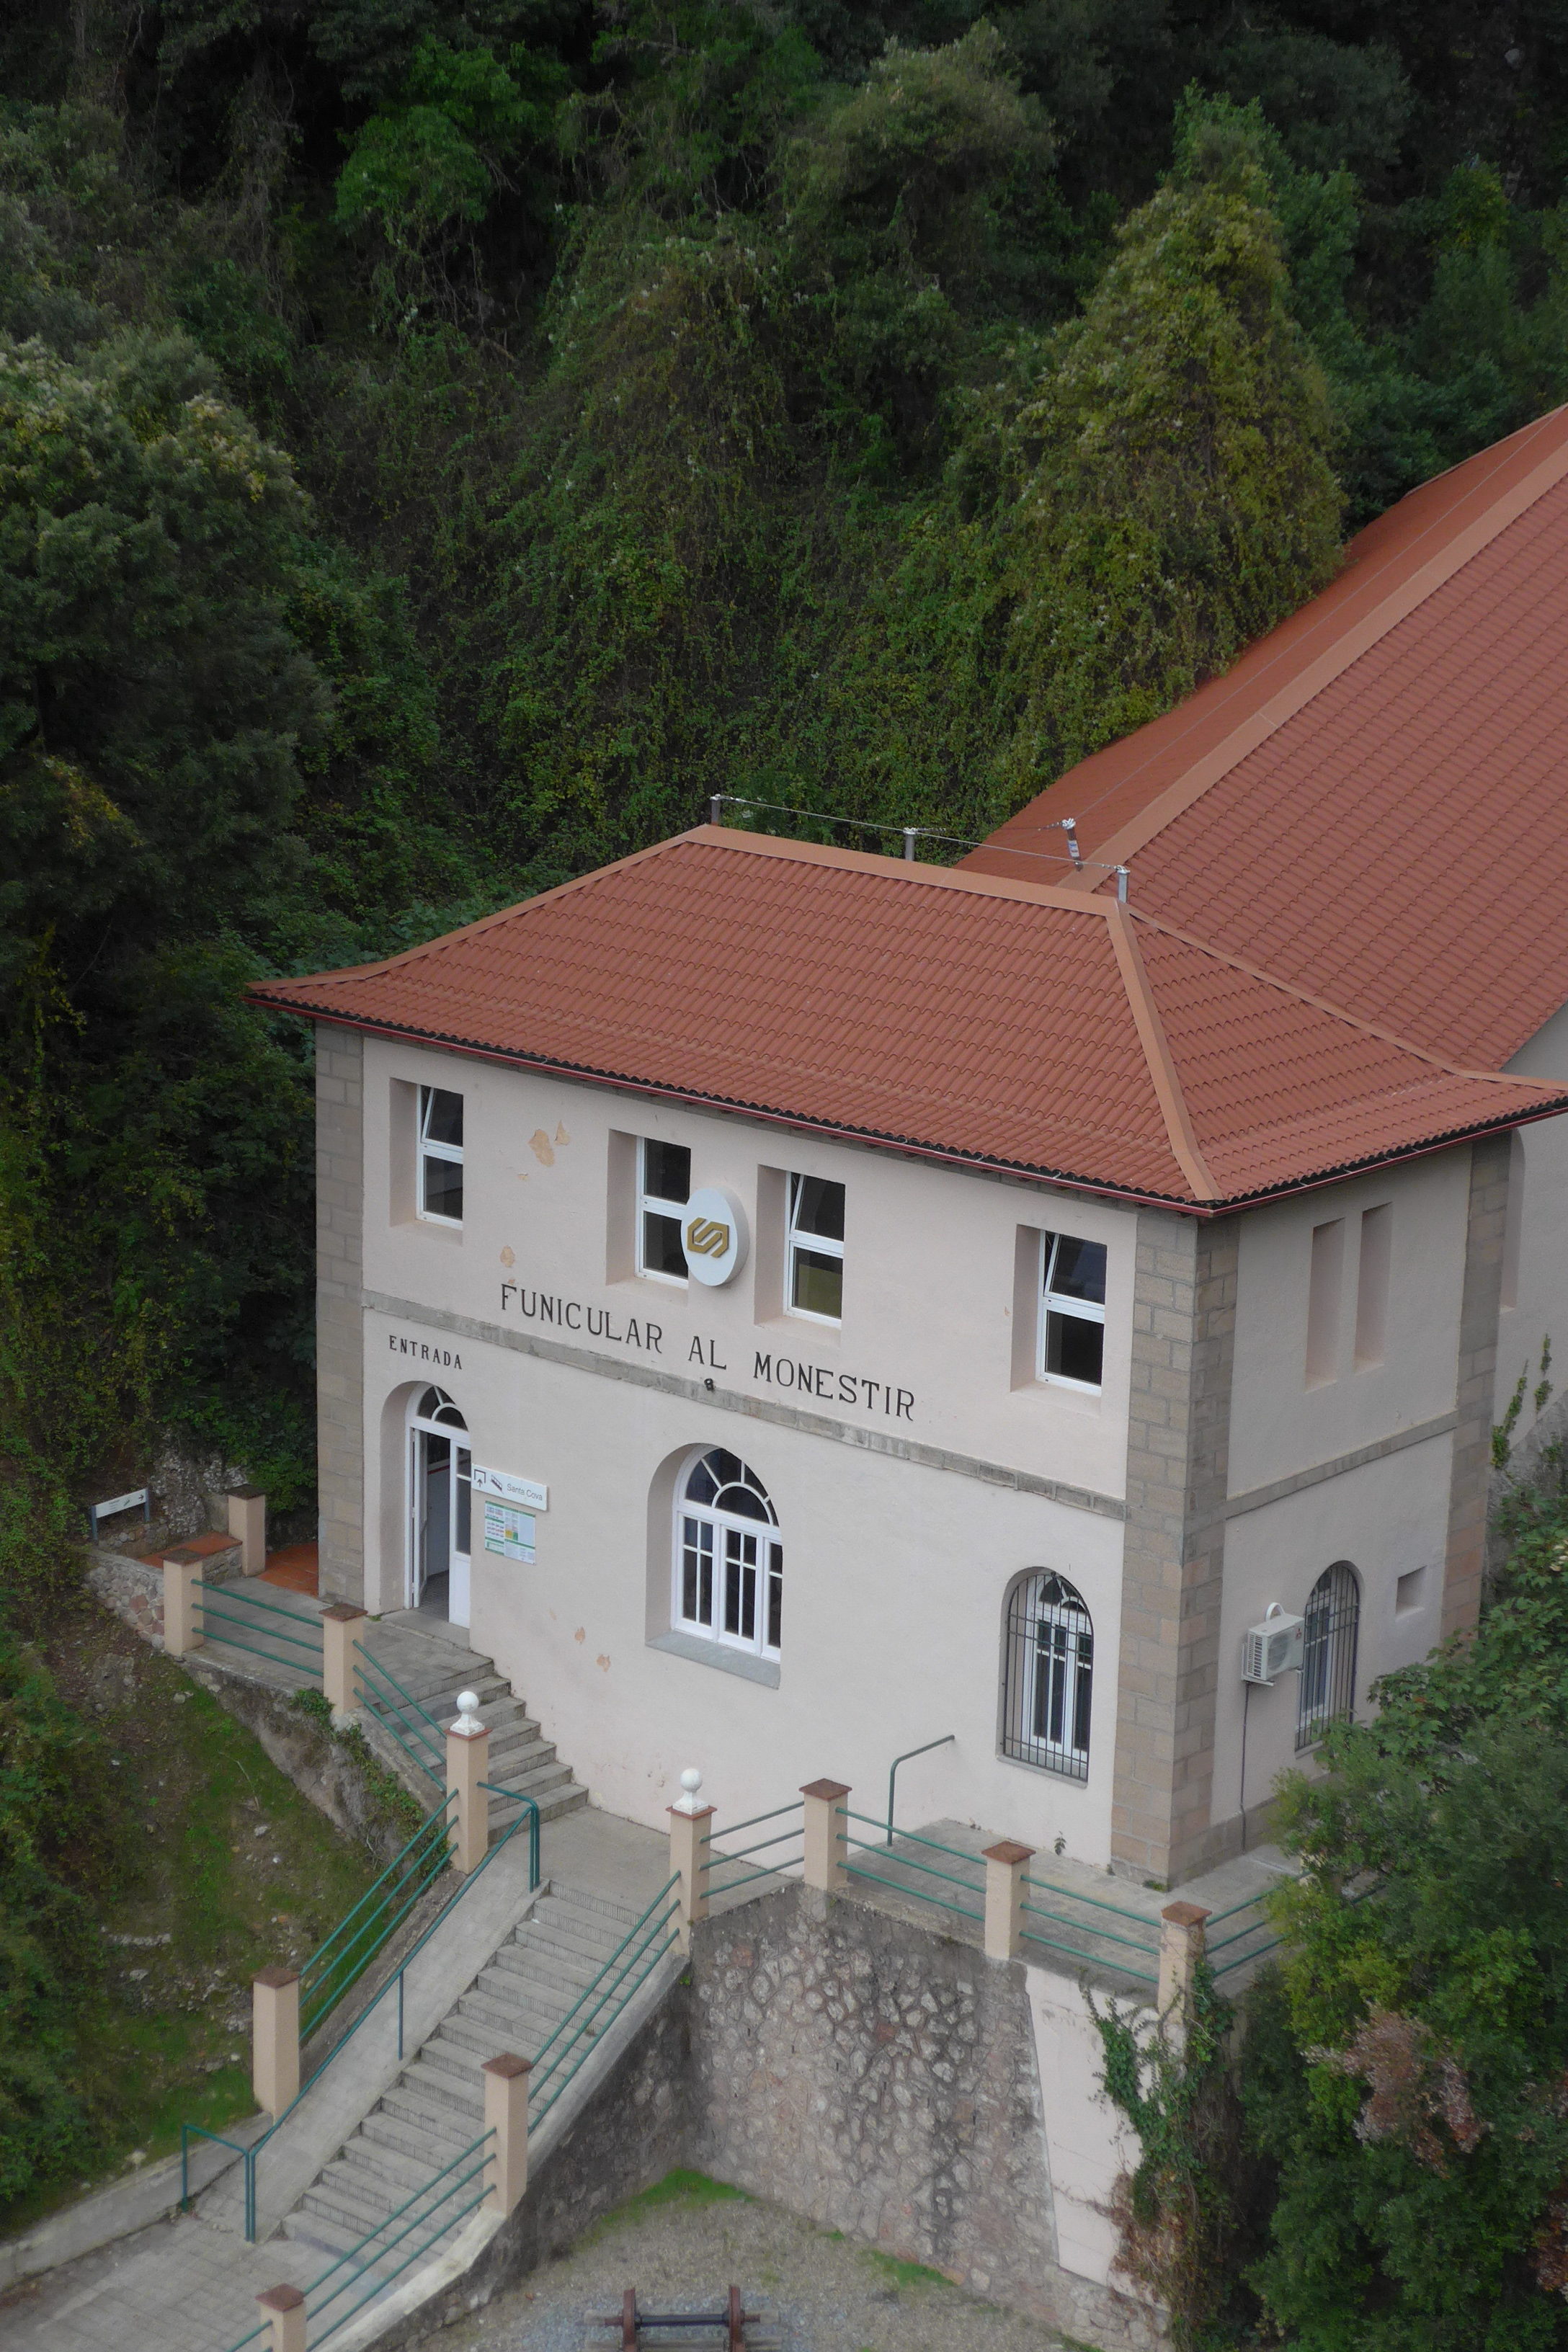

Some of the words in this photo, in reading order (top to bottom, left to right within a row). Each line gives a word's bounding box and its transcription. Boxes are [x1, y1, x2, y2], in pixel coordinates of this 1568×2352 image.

[389, 1335, 463, 1370] ENTRADA
[501, 1283, 662, 1353] FUNICULAR
[687, 1335, 726, 1370] AL
[753, 1351, 915, 1421] MONESTIR
[507, 1483, 525, 1495] Santa
[526, 1489, 543, 1500] Cova
